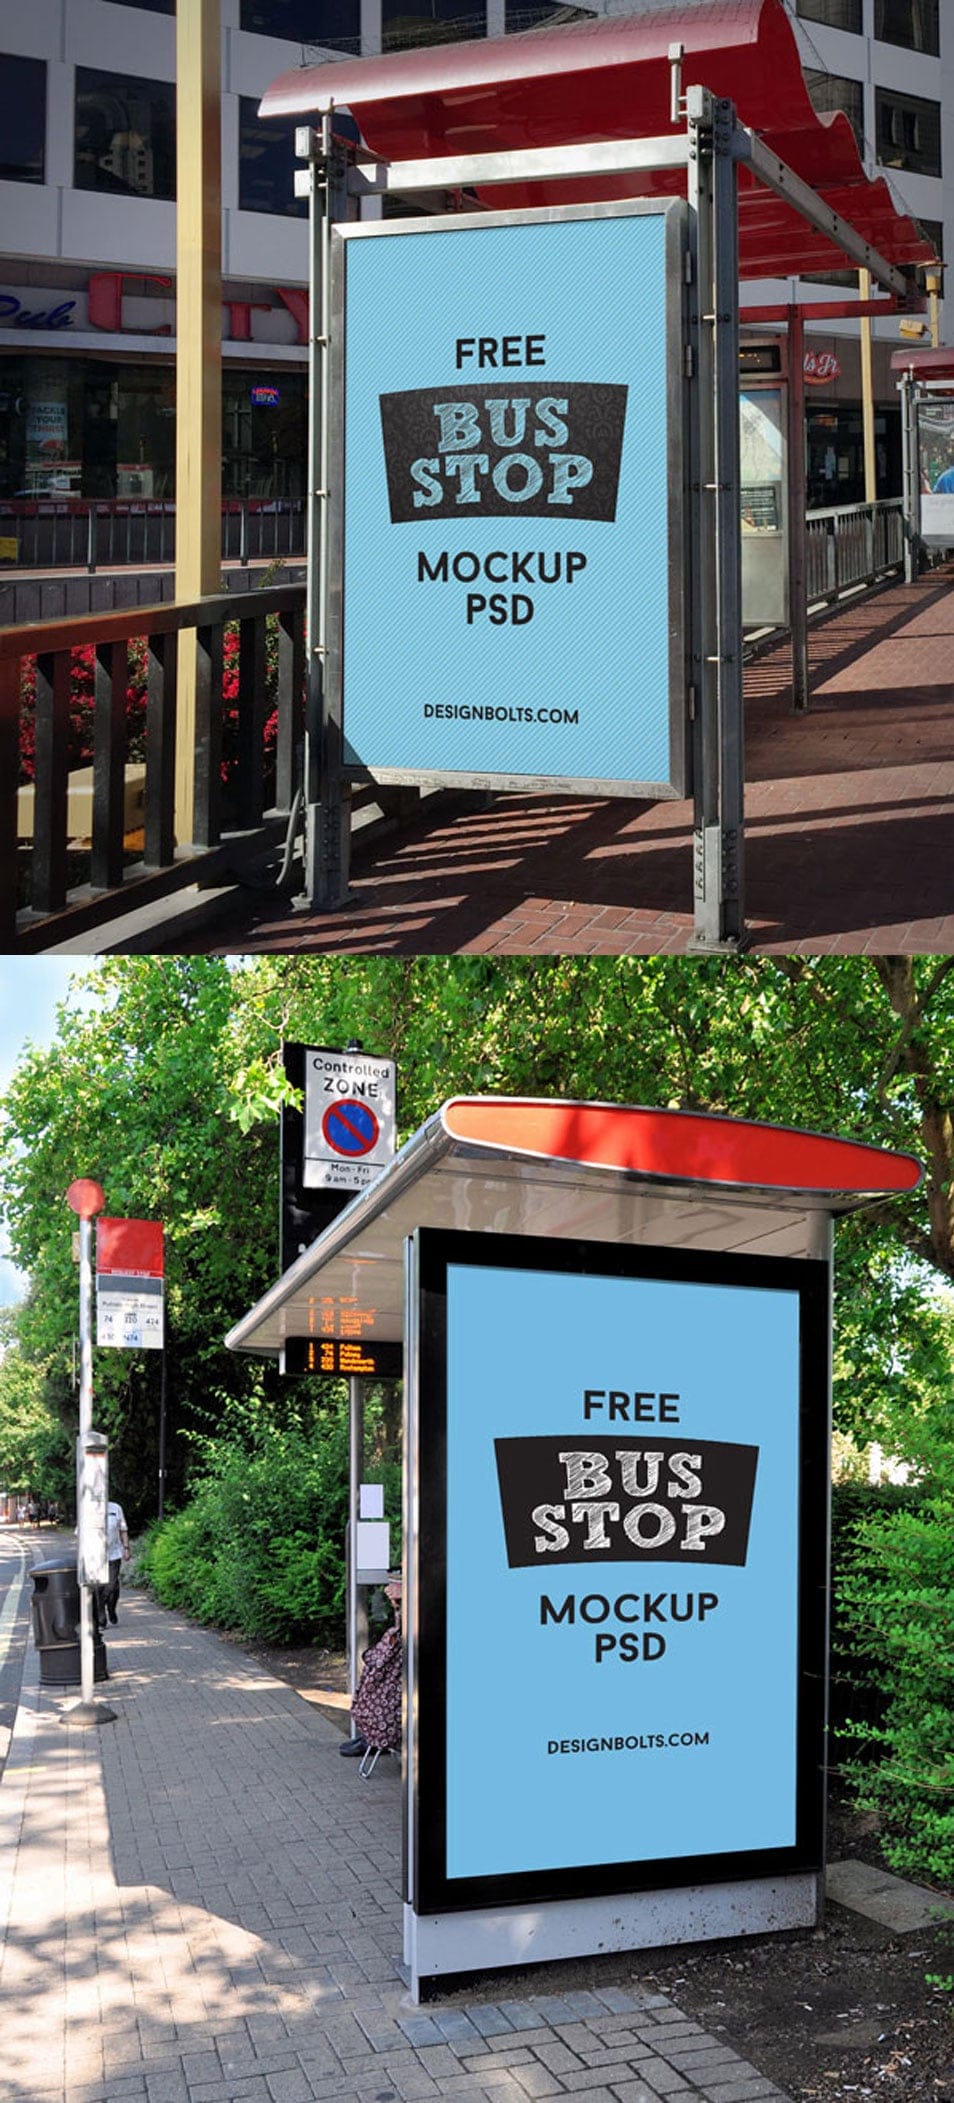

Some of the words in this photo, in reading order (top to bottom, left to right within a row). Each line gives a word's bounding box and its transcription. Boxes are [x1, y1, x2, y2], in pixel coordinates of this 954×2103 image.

[456, 334, 546, 369] FREE
[433, 396, 570, 453] BUS
[410, 453, 594, 508] STOP
[417, 551, 587, 584] MOCKUP
[467, 593, 534, 626] PSD
[424, 703, 579, 724] DESIGNBOLTS.COM
[313, 1057, 390, 1079] Controlled
[323, 1077, 378, 1098] ZONE
[584, 1390, 680, 1423] FREE
[558, 1450, 703, 1500] BUS
[531, 1501, 726, 1553] STOP
[540, 1592, 719, 1625] MOCKUP
[595, 1632, 666, 1663] PSD
[547, 1732, 709, 1755] DESIGNBOLTS.COM
